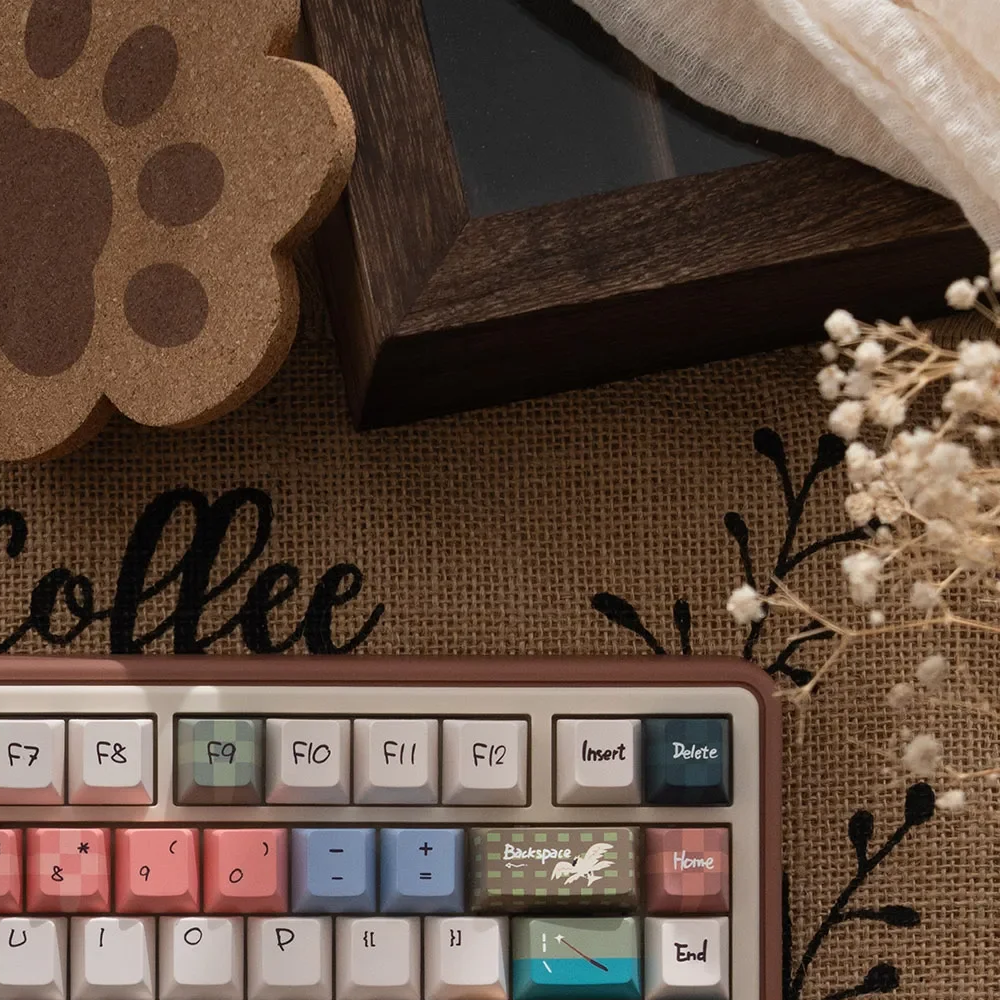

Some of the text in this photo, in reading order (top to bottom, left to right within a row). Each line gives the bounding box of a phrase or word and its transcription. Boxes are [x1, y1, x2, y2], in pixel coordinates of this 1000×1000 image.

[7, 743, 40, 766] F7
[96, 741, 127, 764] F8
[207, 741, 237, 764] F9
[293, 741, 331, 764] F10
[383, 741, 417, 765] F11
[472, 743, 506, 767] F12
[582, 740, 626, 762] Insert
[672, 742, 718, 760] Delete
[419, 842, 432, 856] +
[503, 843, 571, 865] Backspace
[673, 851, 714, 871] Home
[51, 866, 64, 882] 8
[139, 866, 150, 881] 9
[8, 929, 27, 948] U
[99, 928, 105, 947] I
[184, 927, 202, 945] O
[275, 928, 294, 951] P
[674, 939, 707, 962] End
